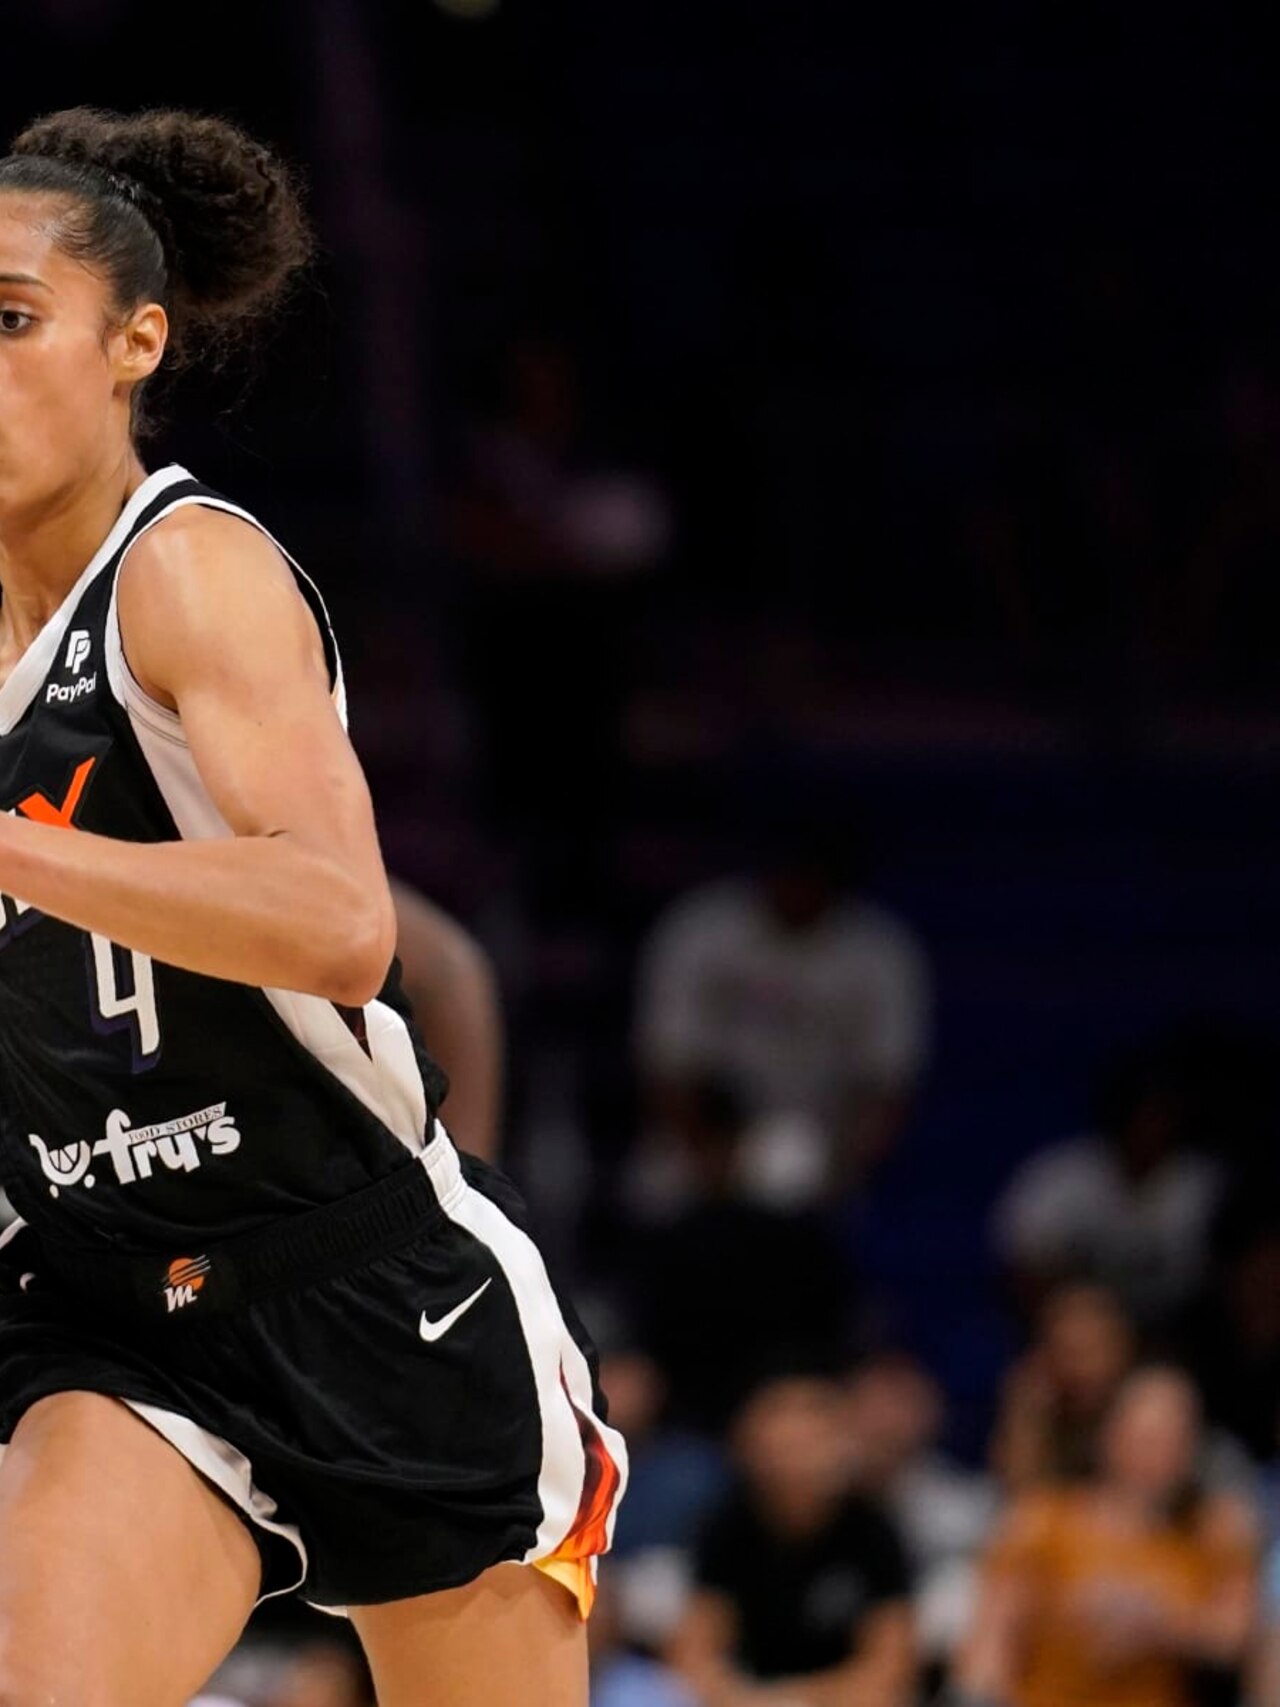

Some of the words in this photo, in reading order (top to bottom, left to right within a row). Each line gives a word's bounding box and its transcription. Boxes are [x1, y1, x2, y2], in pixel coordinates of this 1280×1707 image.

[46, 672, 96, 703] PayPal
[89, 931, 161, 1060] 4
[128, 1126, 161, 1144] FOOD
[166, 1106, 223, 1135] STORES
